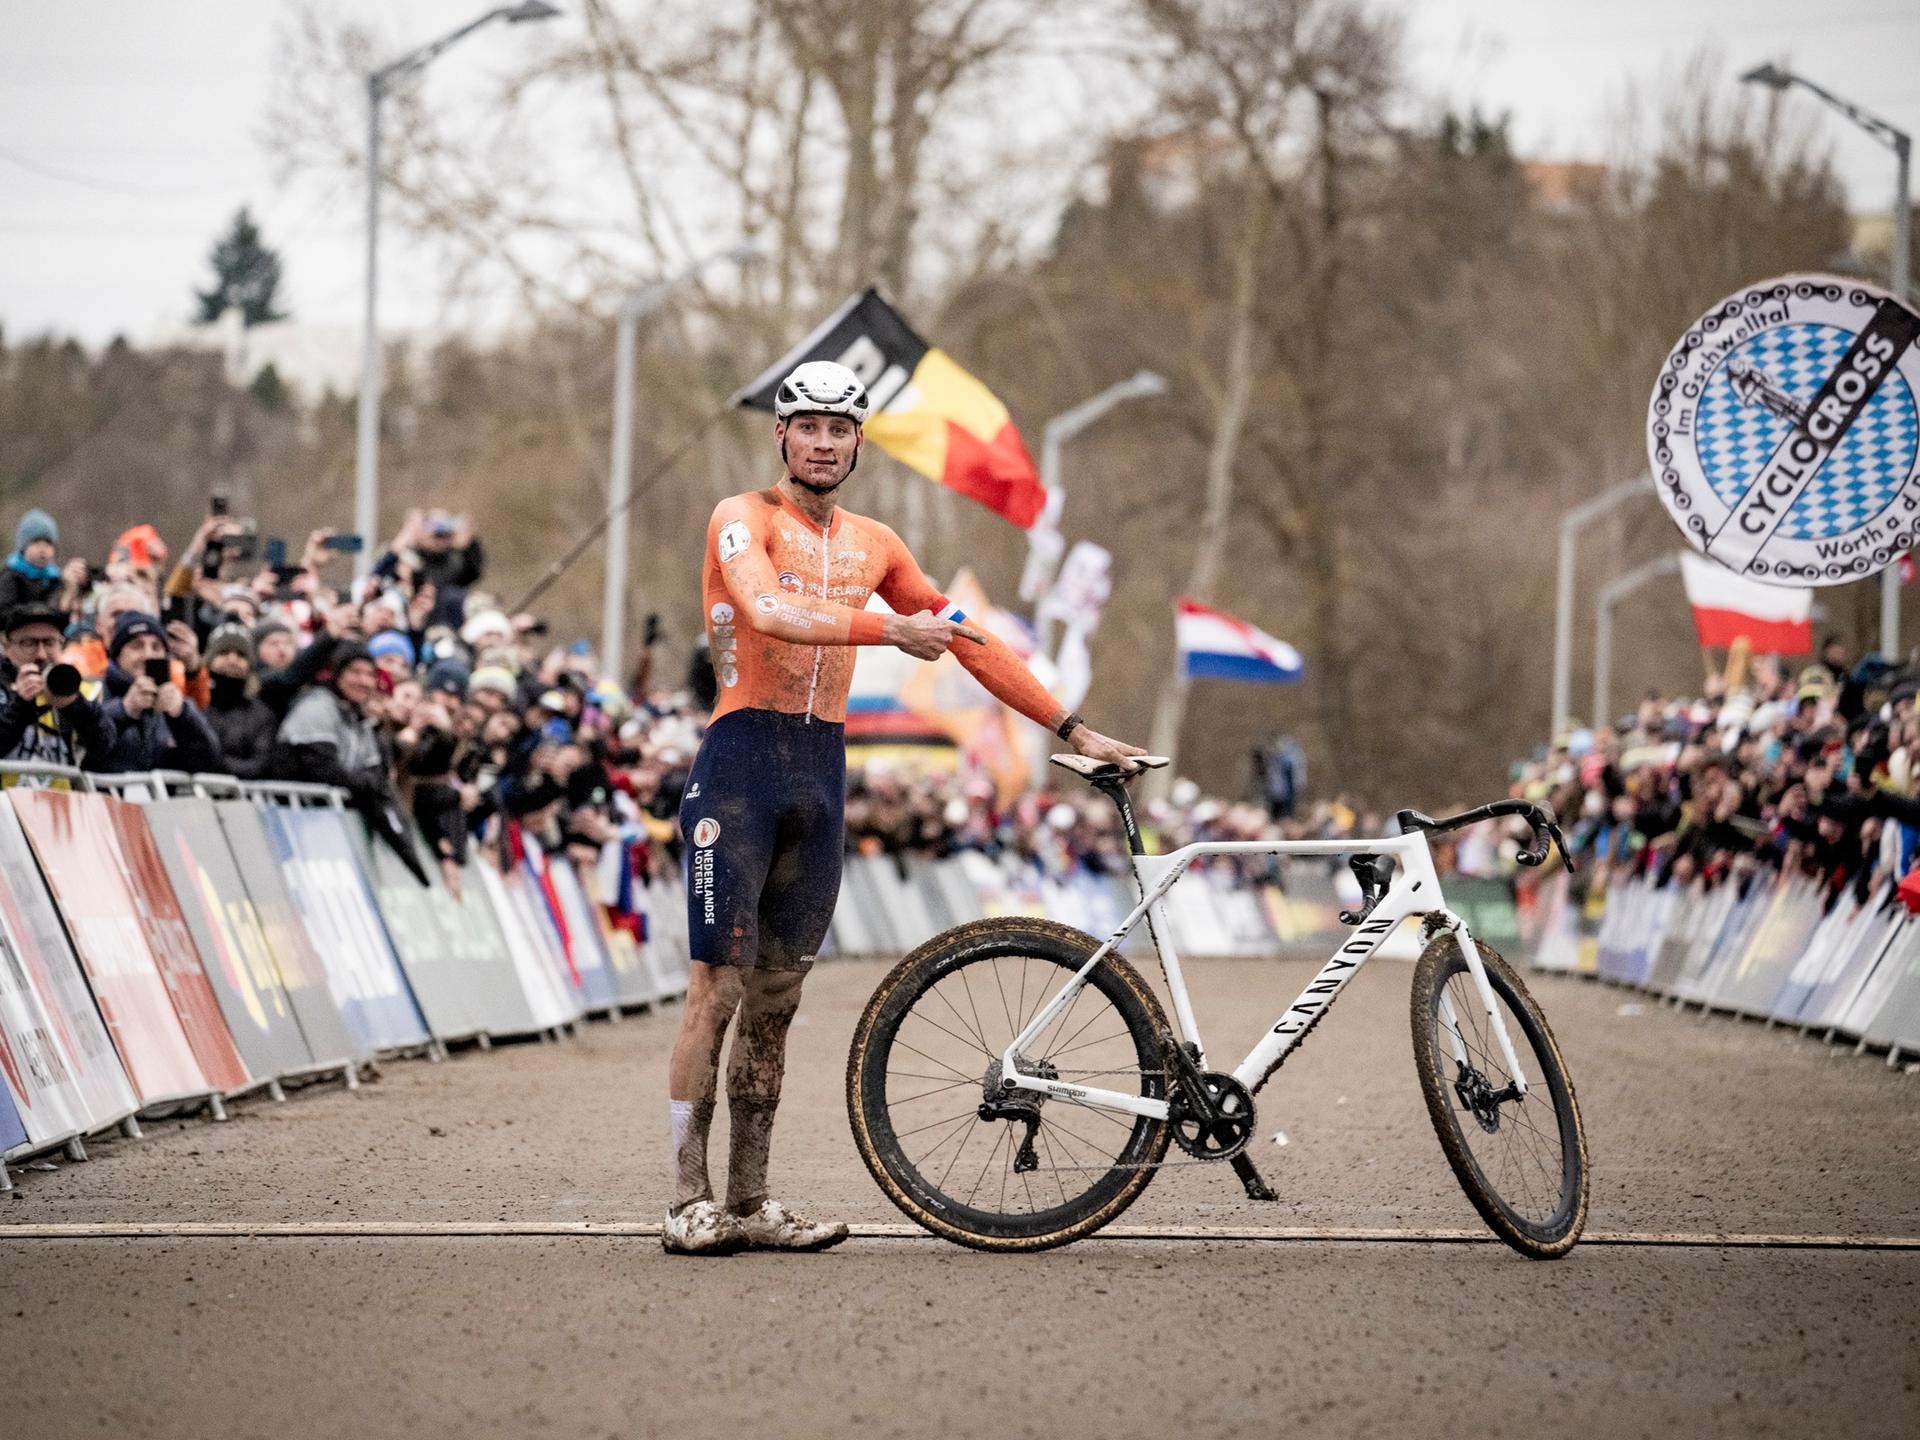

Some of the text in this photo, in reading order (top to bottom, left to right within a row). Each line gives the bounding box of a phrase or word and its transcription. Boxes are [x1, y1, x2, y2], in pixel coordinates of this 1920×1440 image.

[1673, 302, 1790, 436] Im Gschwelltal
[1739, 332, 1895, 535] CYCLOCROSS
[727, 533, 735, 548] 1
[780, 602, 838, 625] NEDERLANDSE
[1122, 803, 1136, 837] CANYON
[703, 849, 715, 925] NEDERLANDSE
[1273, 919, 1396, 1035] CANYON
[1047, 1084, 1087, 1098] SHIMANO
